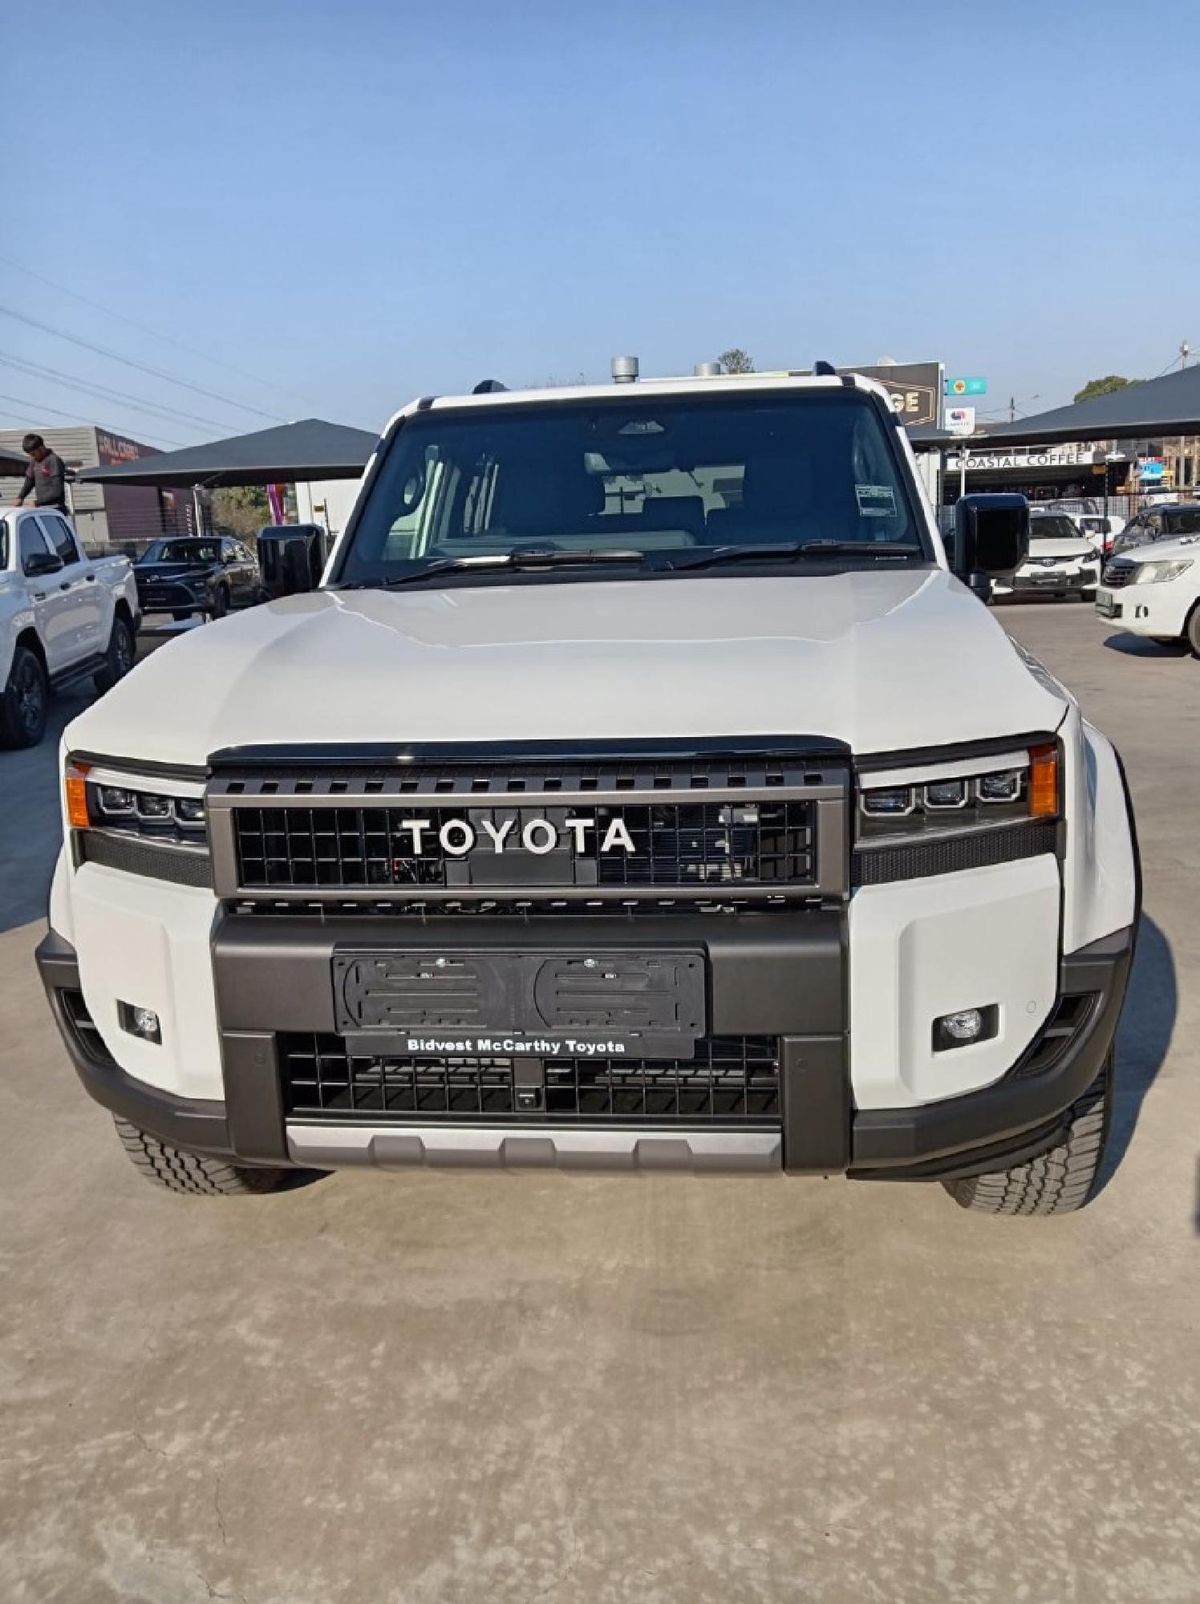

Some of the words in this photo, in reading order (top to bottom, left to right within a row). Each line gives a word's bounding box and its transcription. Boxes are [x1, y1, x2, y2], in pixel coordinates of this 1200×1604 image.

[955, 455, 1021, 469] COASTAL
[1027, 452, 1084, 465] COFFEE
[402, 818, 636, 855] TOYOTA
[407, 1038, 473, 1052] Bidvest
[477, 1038, 561, 1055] McCarthy
[565, 1039, 625, 1054] Toyota
